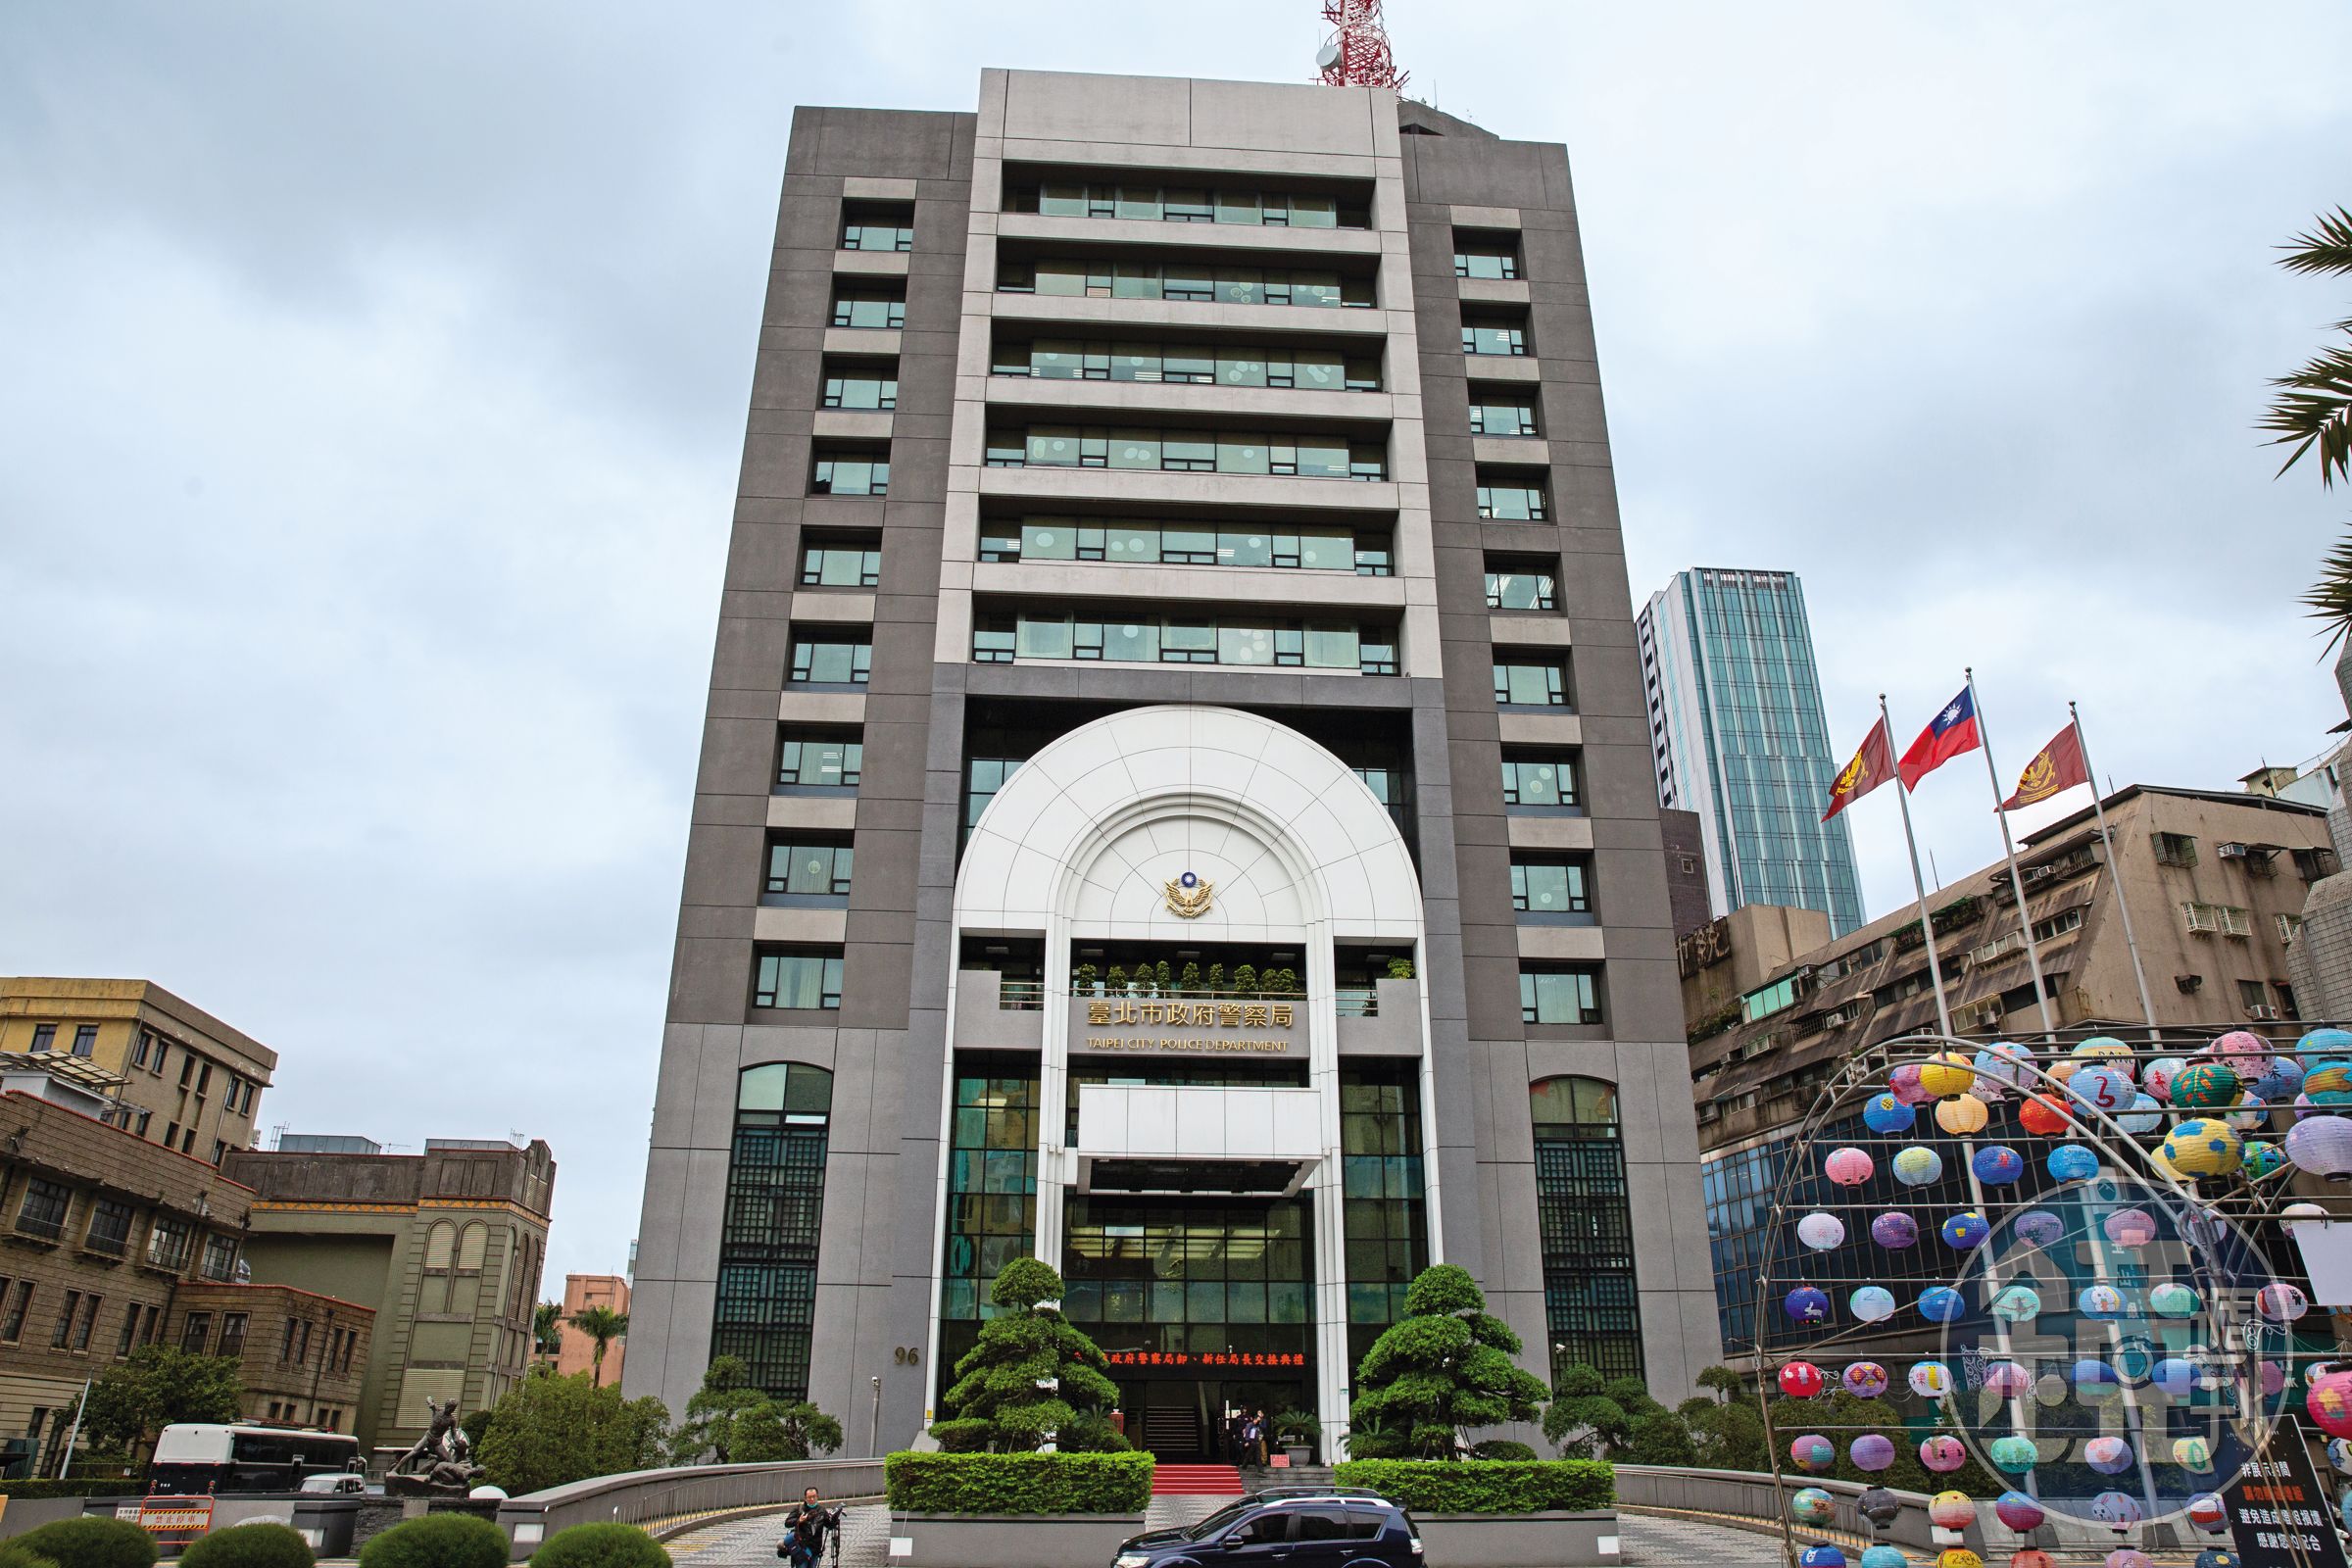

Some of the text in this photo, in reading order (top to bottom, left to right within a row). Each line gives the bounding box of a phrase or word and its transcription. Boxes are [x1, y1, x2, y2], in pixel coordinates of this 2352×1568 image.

[1088, 1001, 1294, 1028] 臺北市政府警察局
[1087, 1037, 1289, 1052] TAIPEI CITY POLICE DEPARTMENT
[894, 1347, 919, 1365] 96
[155, 1514, 196, 1524] 禁止停車
